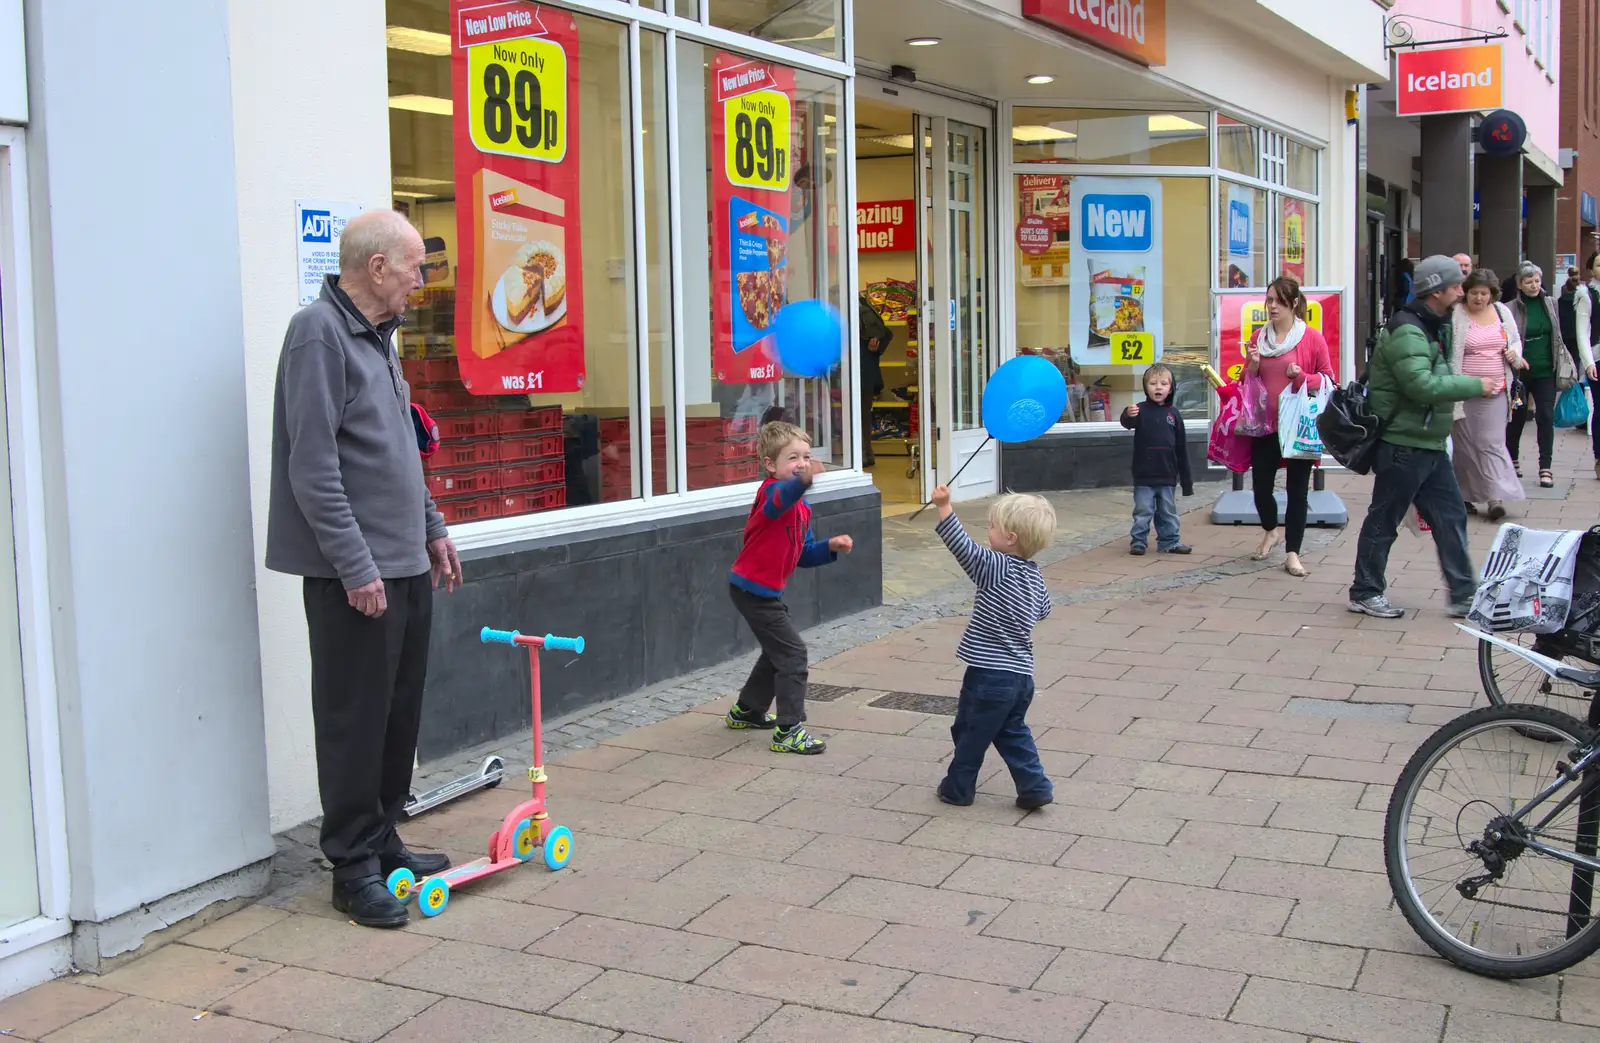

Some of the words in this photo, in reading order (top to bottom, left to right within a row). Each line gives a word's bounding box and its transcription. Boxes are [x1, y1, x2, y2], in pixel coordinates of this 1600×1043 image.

[465, 18, 488, 36] New
[488, 14, 507, 32] Low
[507, 10, 532, 29] Price
[493, 44, 517, 63] Now
[520, 51, 545, 73] Only
[722, 76, 737, 91] New
[736, 73, 748, 87] Low
[748, 67, 765, 83] Price
[1408, 67, 1492, 92] Iceland
[483, 63, 558, 150] 89p
[741, 98, 756, 111] Now
[758, 101, 775, 119] Only
[735, 112, 786, 182] 89p
[1023, 177, 1057, 187] delivery
[303, 214, 331, 238] ADT
[332, 215, 347, 226] Fire
[1088, 203, 1146, 238] New
[1231, 209, 1248, 243] New
[1251, 309, 1268, 321] Bu
[1121, 340, 1143, 360] £2
[501, 375, 525, 390] was
[526, 370, 544, 390] £1
[749, 367, 765, 379] was
